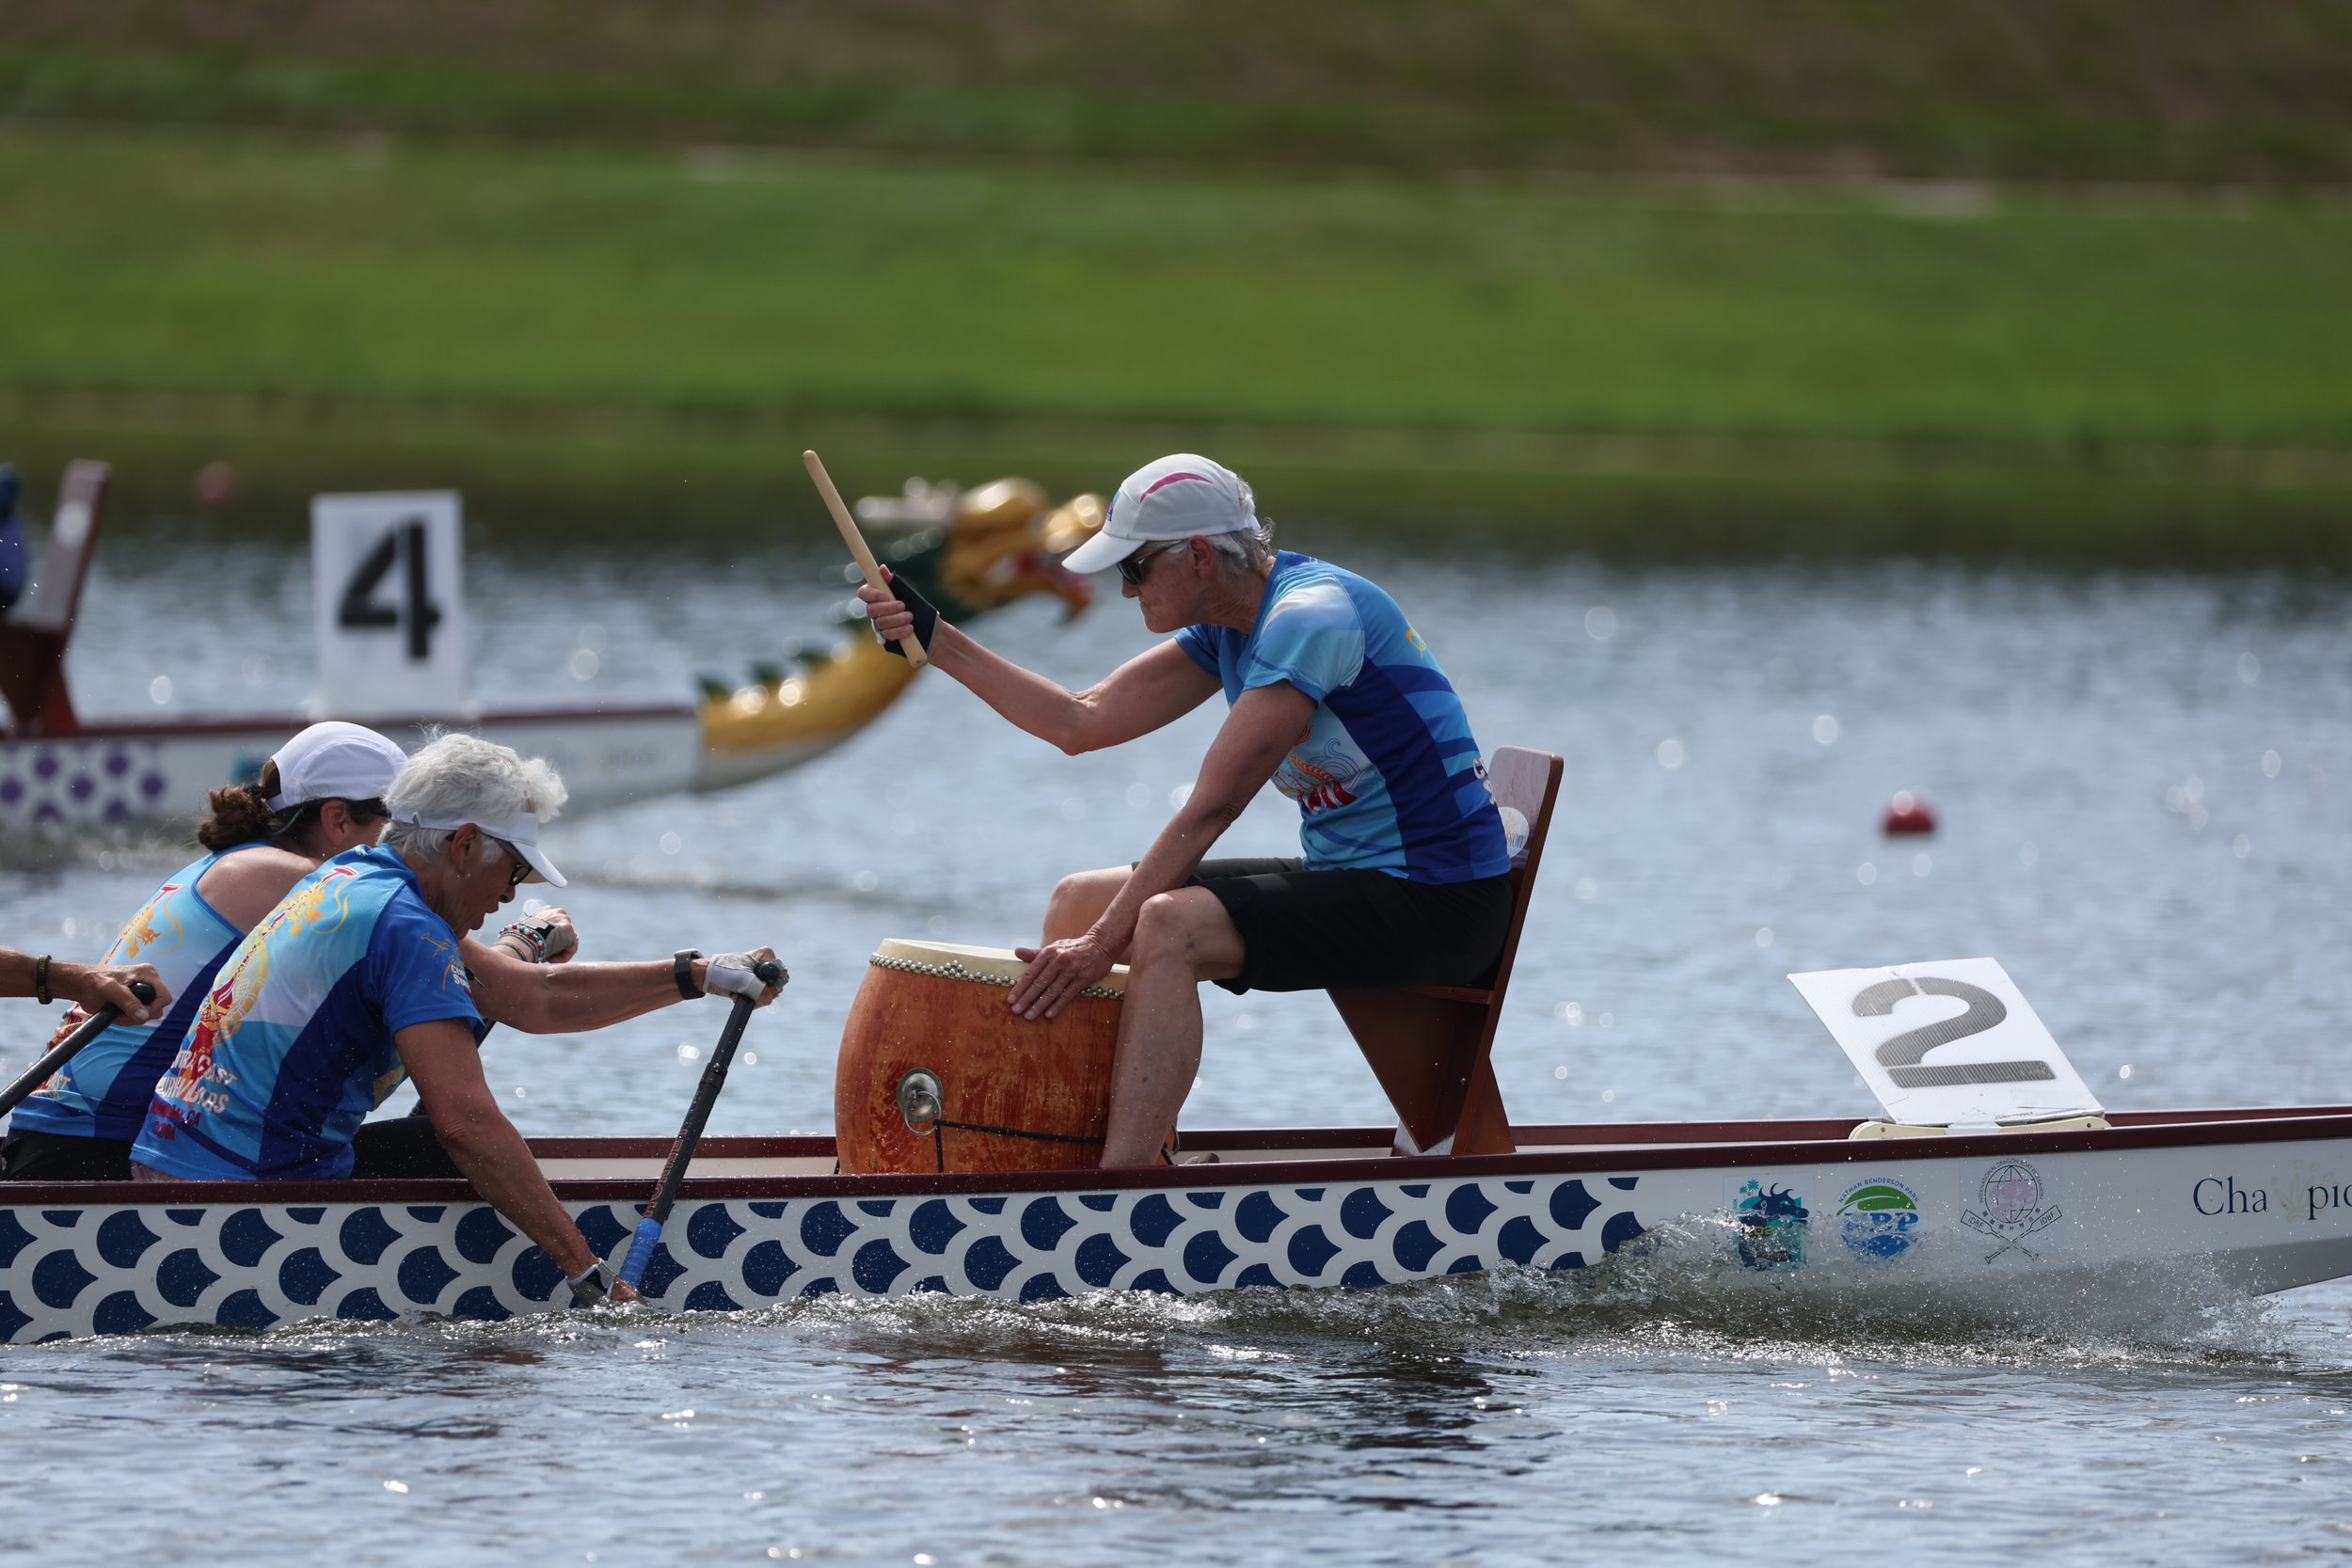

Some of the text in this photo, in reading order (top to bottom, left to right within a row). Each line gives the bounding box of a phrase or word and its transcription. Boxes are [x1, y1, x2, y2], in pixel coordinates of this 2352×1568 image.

[337, 515, 441, 660] 4
[1851, 976, 2057, 1088] 2
[1838, 1177, 1919, 1204] NATHAN BENDERSON PARK
